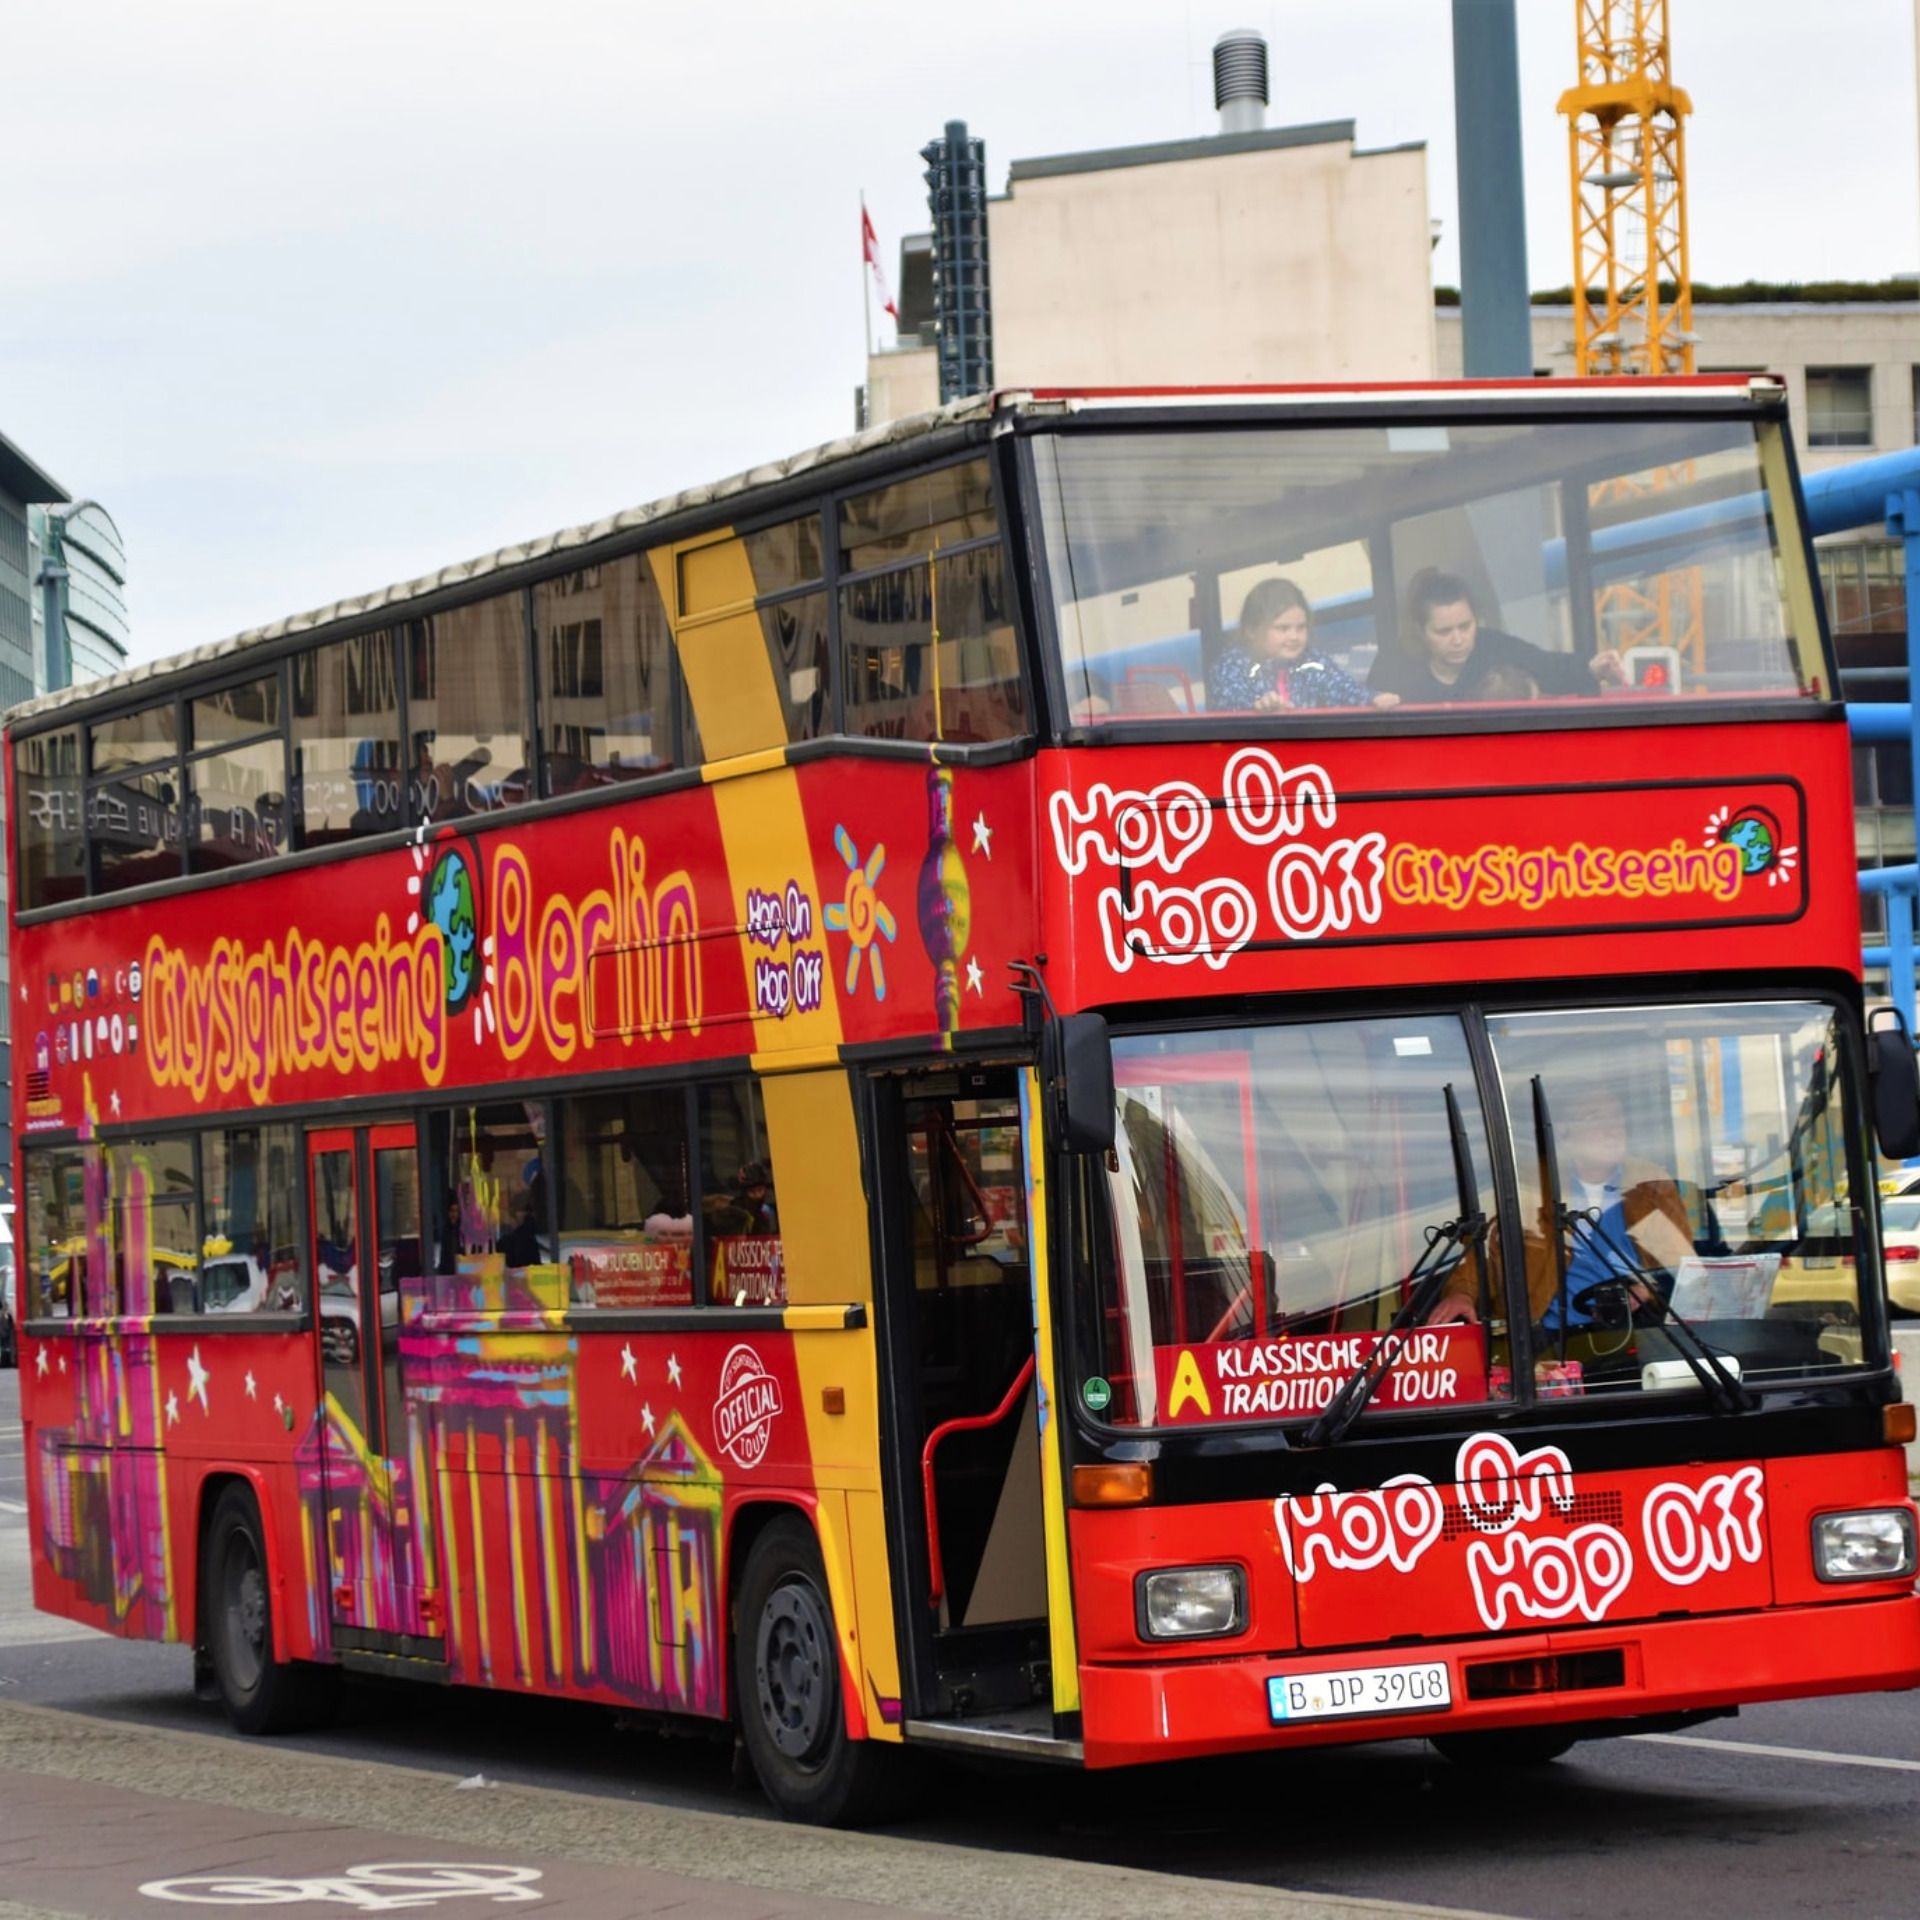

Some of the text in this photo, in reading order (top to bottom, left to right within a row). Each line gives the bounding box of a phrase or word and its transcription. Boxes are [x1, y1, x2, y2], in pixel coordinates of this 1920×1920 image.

[1050, 747, 1336, 875] Hop On
[1098, 831, 1386, 972] Hop Off
[1386, 838, 1743, 911] CitySightseeing
[747, 879, 811, 950] Hop On
[145, 826, 701, 1105] CitySightseeing Berlin
[755, 949, 823, 1018] Hop Off
[1216, 1338, 1363, 1378] KLASSISCHE
[1393, 1368, 1457, 1402] TOUR
[719, 1382, 778, 1440] OFFICIAL
[740, 1425, 767, 1458] TOUR
[1274, 1431, 1574, 1582] Hop On
[1466, 1466, 1764, 1630] Hop Off
[1289, 1669, 1443, 1710] B DP 3908
